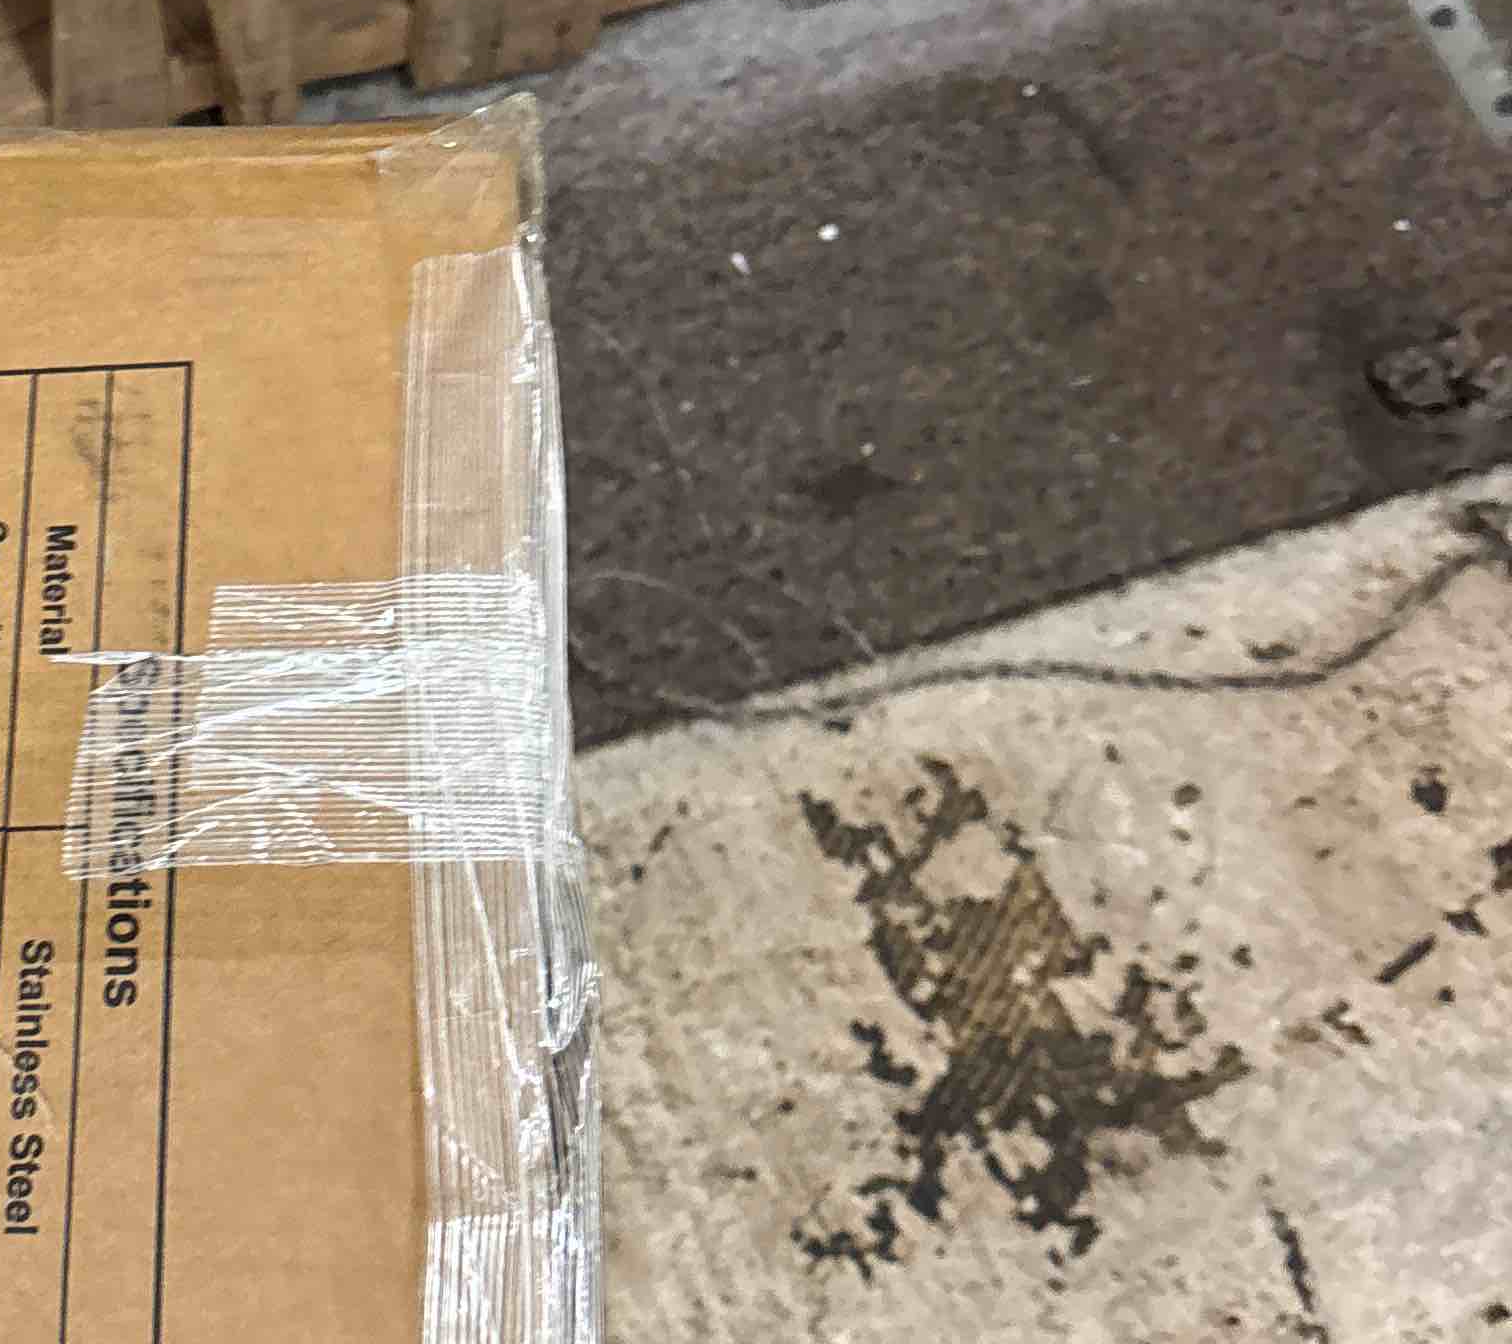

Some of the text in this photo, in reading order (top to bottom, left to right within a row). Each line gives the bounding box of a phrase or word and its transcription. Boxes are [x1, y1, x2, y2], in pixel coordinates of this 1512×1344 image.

[39, 524, 77, 655] Material
[4, 938, 56, 1234] Stainless Steel
